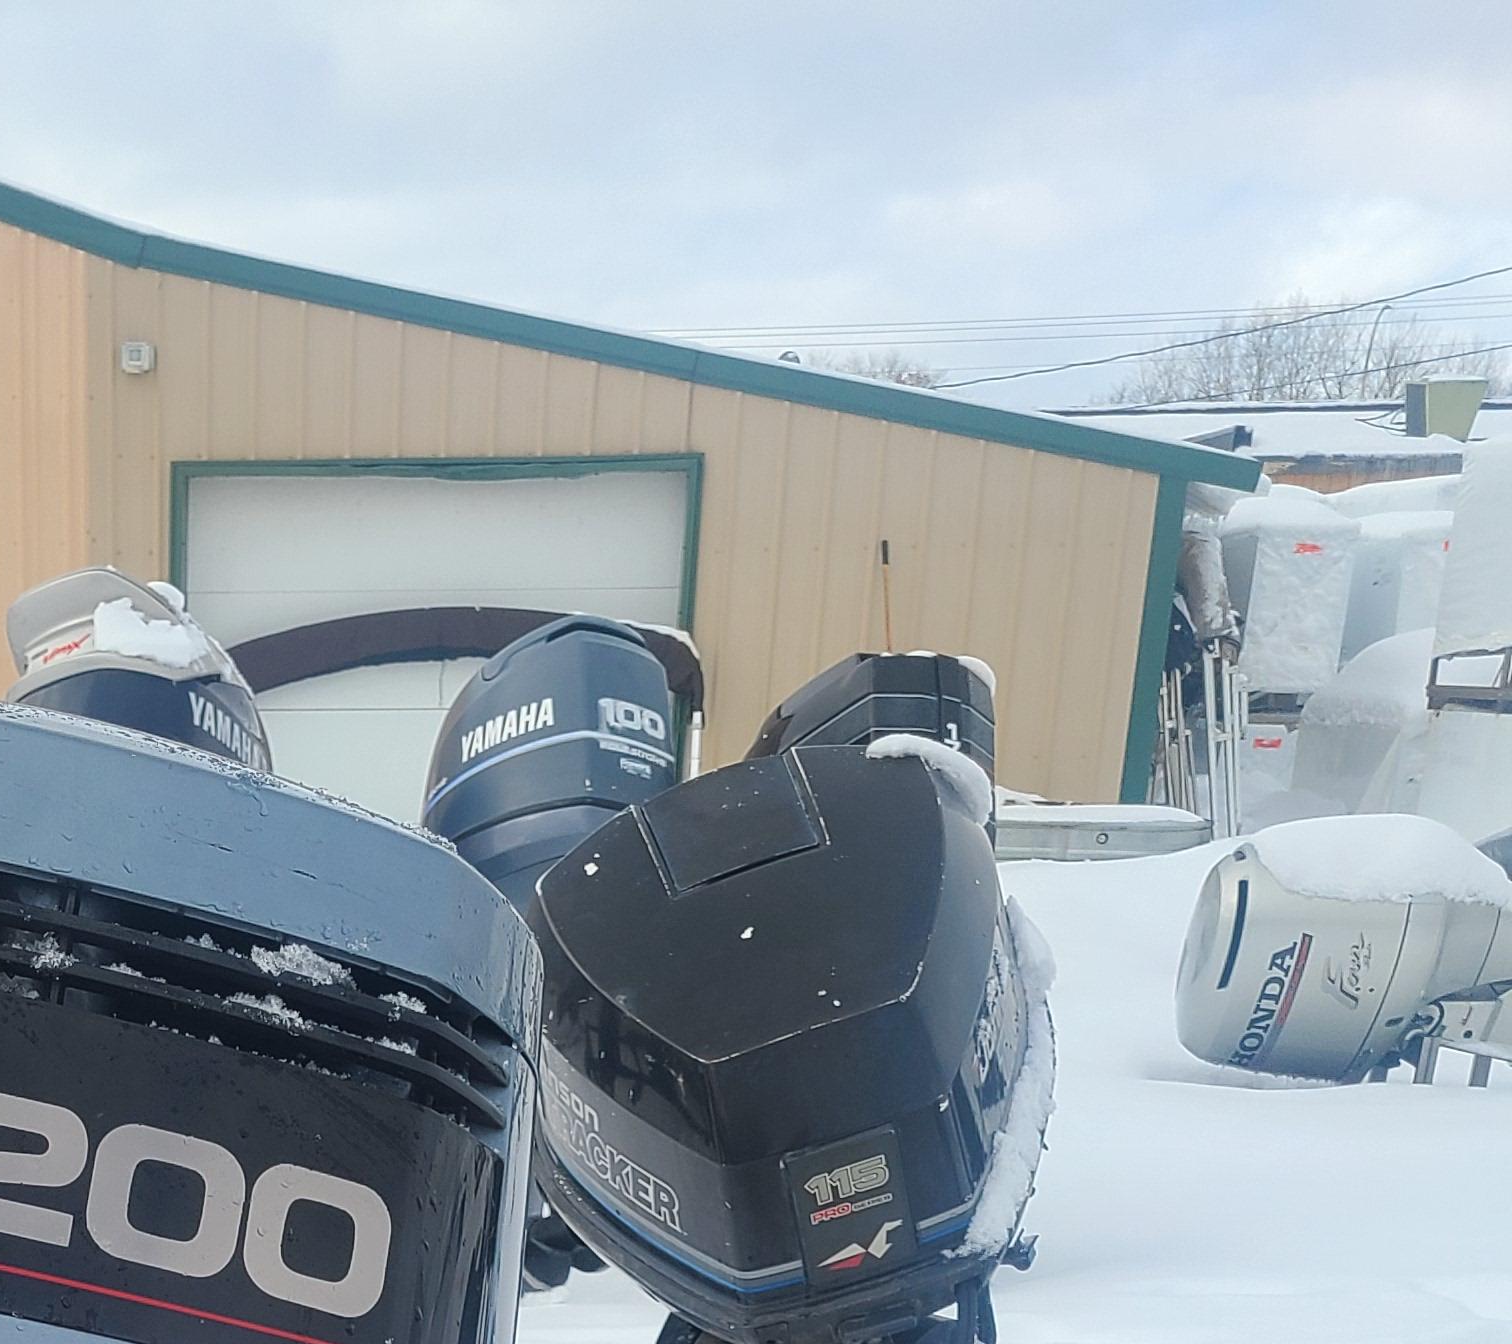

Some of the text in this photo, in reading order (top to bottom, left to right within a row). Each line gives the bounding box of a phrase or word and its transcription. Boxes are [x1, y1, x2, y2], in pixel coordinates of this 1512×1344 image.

[188, 691, 269, 771] YAMAHA
[461, 697, 555, 763] YAMAHA
[597, 698, 665, 740] 100
[1228, 941, 1298, 1066] HONDA
[804, 1153, 890, 1206] 115
[810, 1202, 852, 1225] PRO
